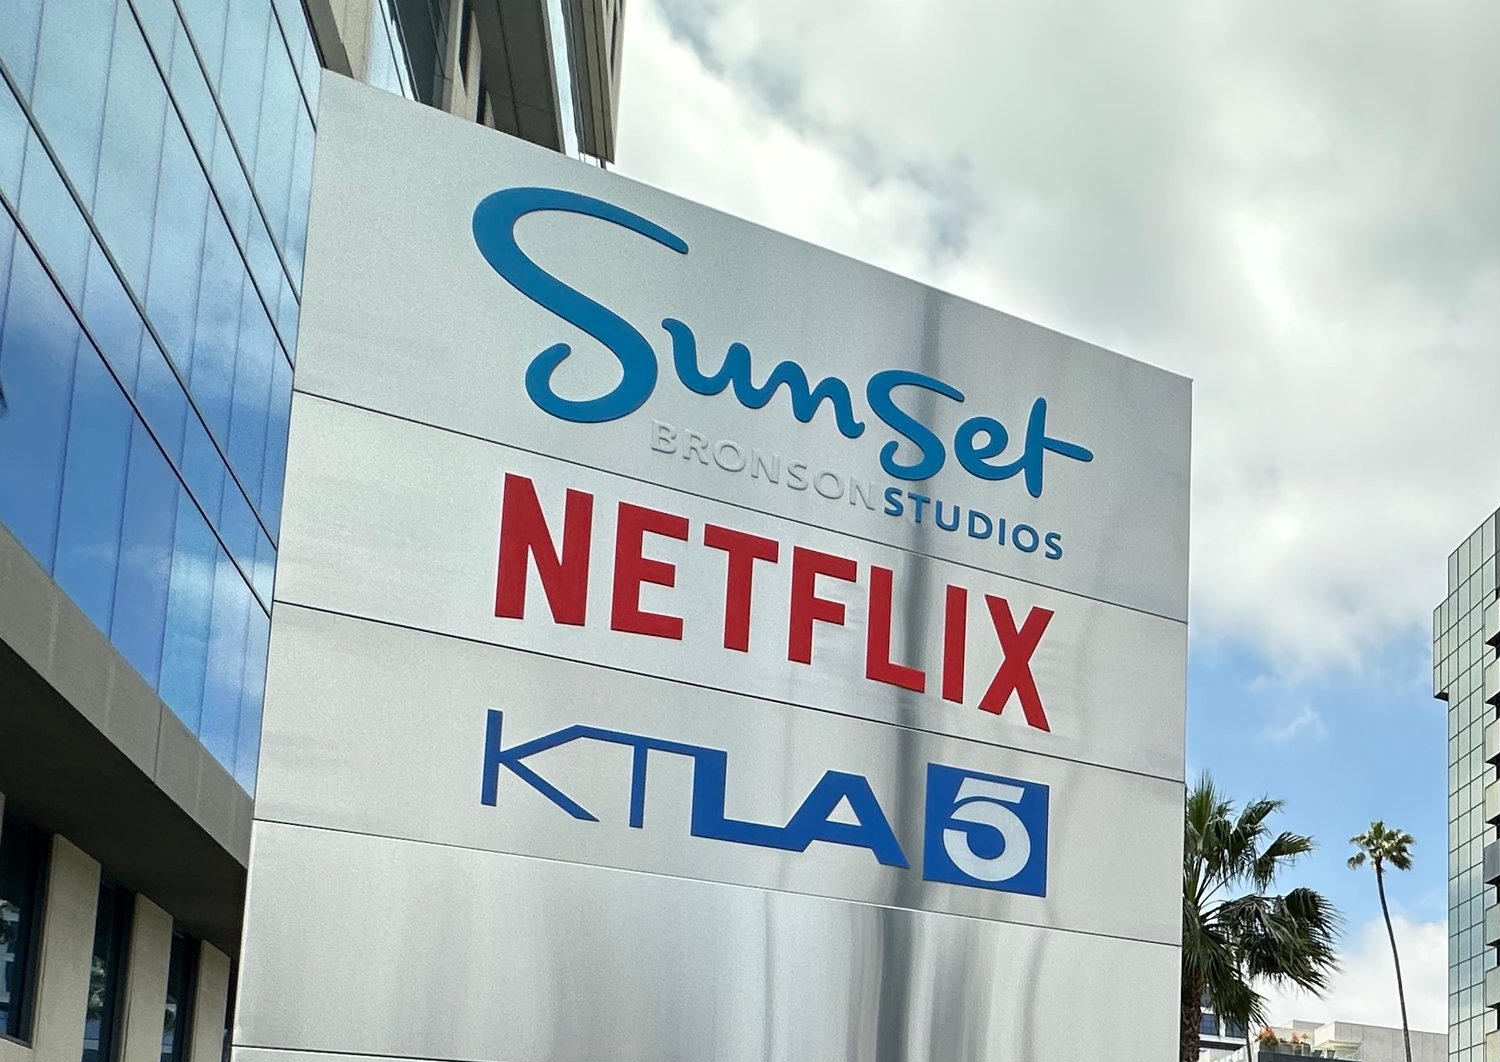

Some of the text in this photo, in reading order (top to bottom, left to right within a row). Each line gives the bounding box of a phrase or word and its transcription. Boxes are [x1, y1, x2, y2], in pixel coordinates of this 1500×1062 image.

[651, 420, 1064, 561] BRONSON STUDIOS
[494, 473, 1055, 732] NETFLIX
[481, 708, 911, 869] KTLA
